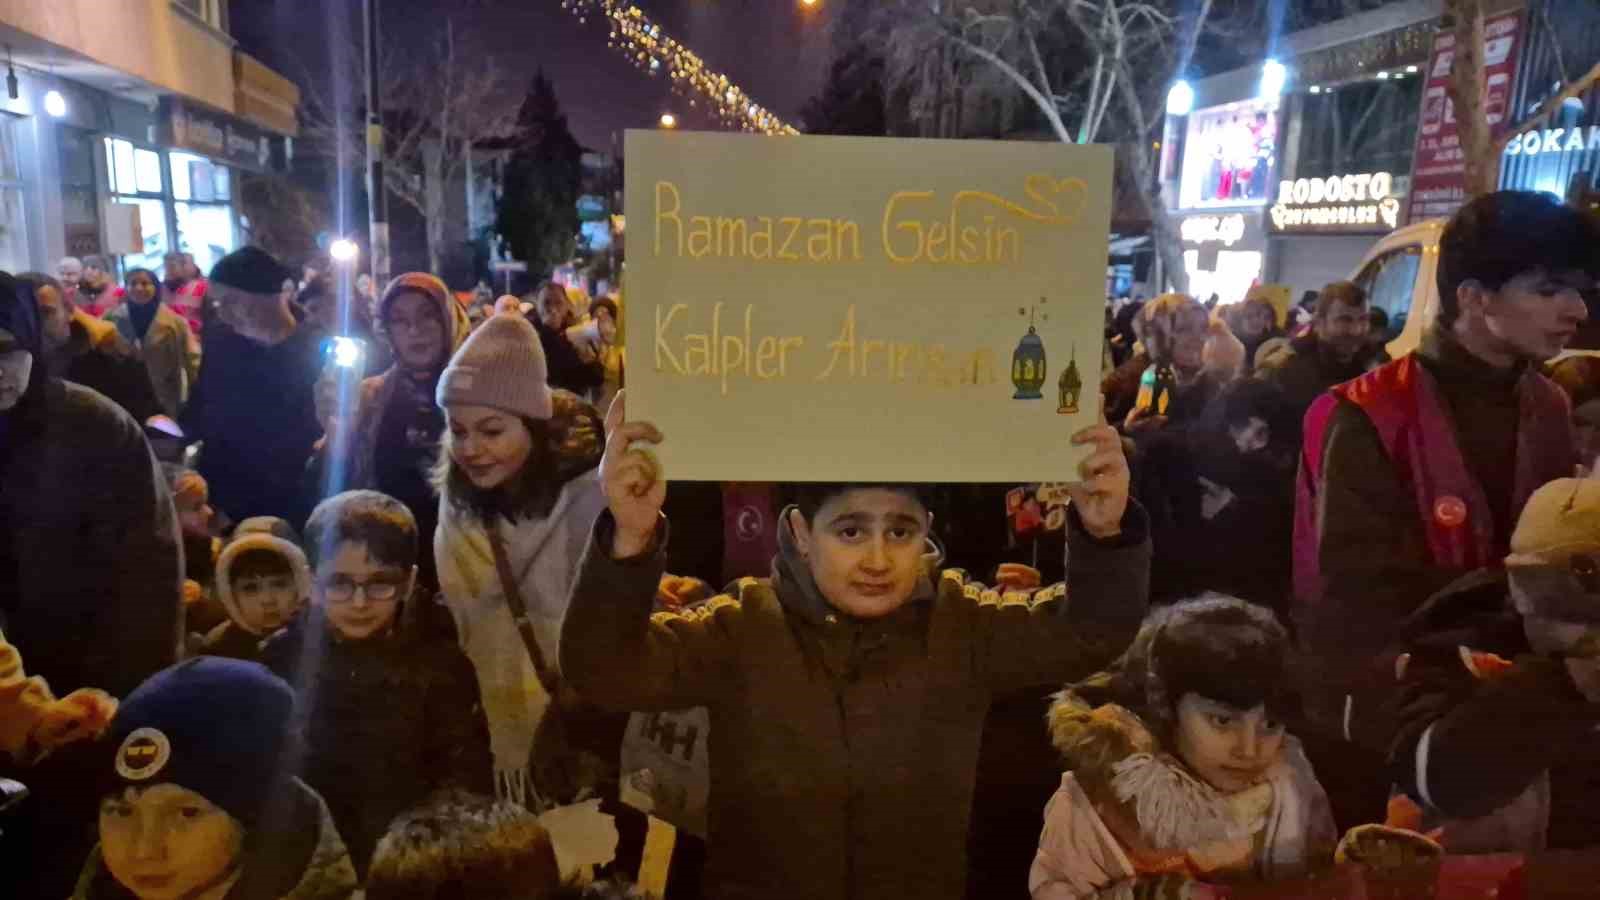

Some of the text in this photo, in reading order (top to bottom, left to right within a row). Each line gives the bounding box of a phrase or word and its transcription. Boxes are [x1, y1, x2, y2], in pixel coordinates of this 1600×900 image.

[654, 180, 1023, 266] Ramazan Gelsin
[655, 298, 804, 396] Kalpler
